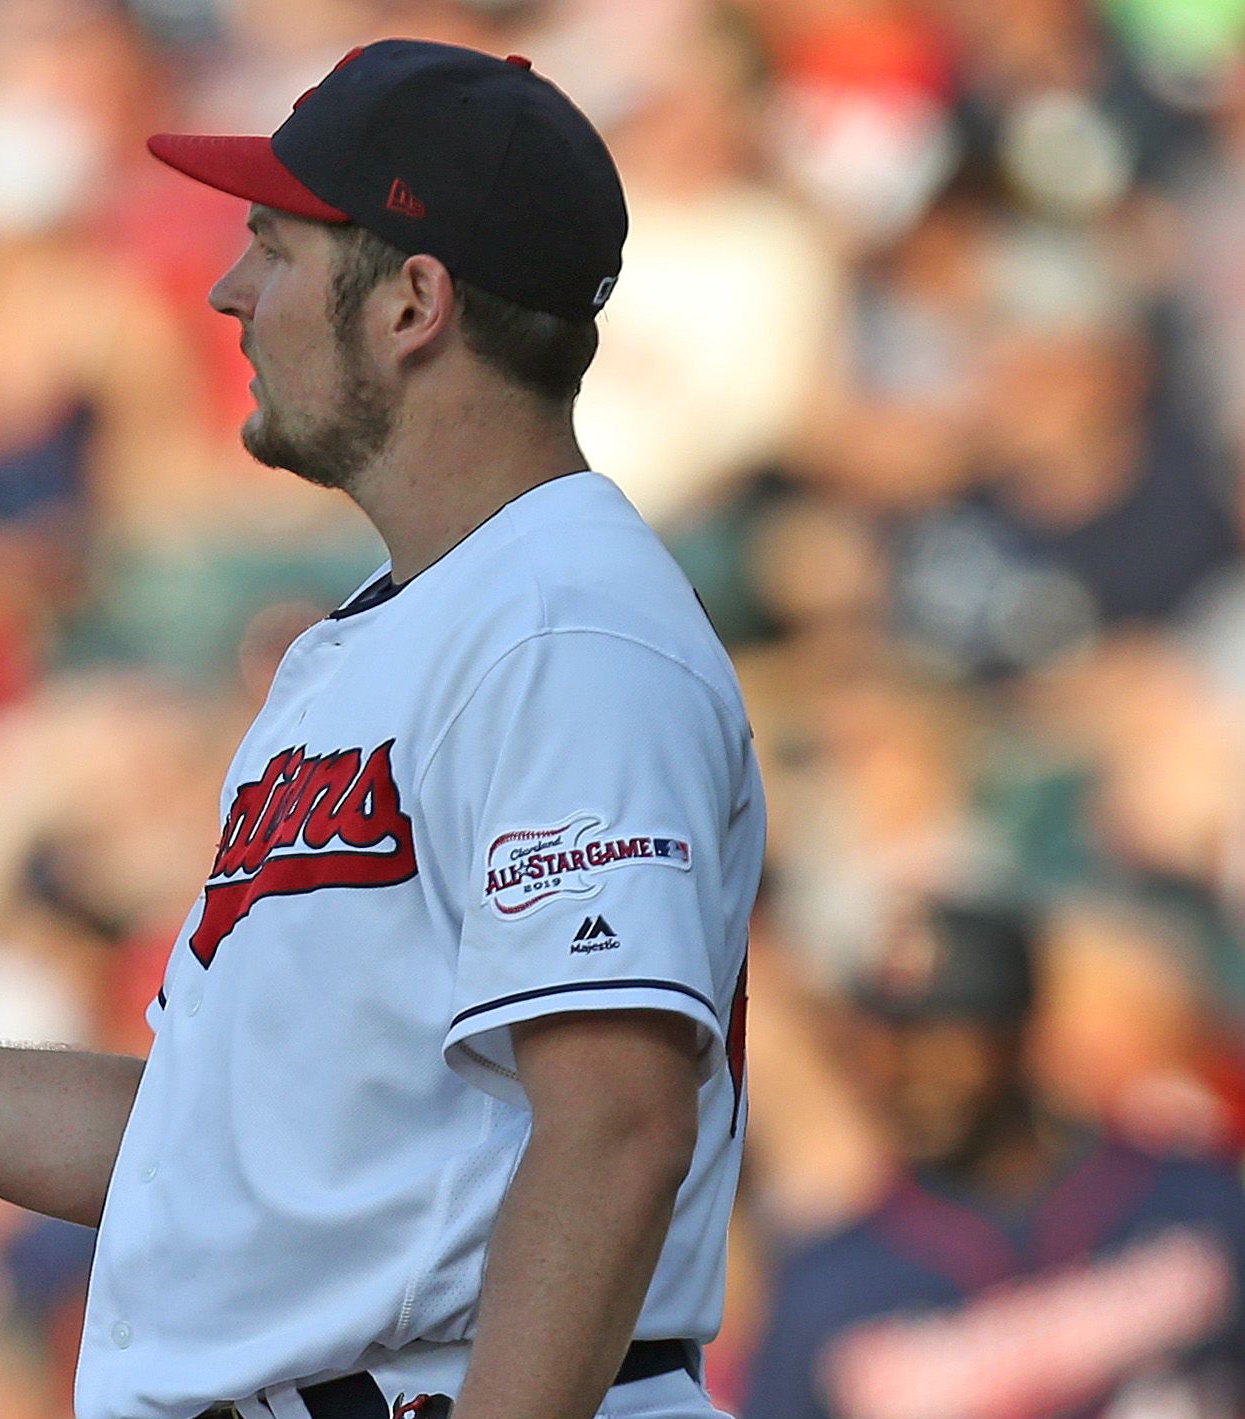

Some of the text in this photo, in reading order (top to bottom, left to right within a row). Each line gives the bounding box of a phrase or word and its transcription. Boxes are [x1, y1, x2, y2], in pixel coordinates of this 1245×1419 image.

[485, 837, 654, 896] ALL STAR GAME
[523, 876, 562, 895] 2019
[569, 938, 621, 955] Majestic
